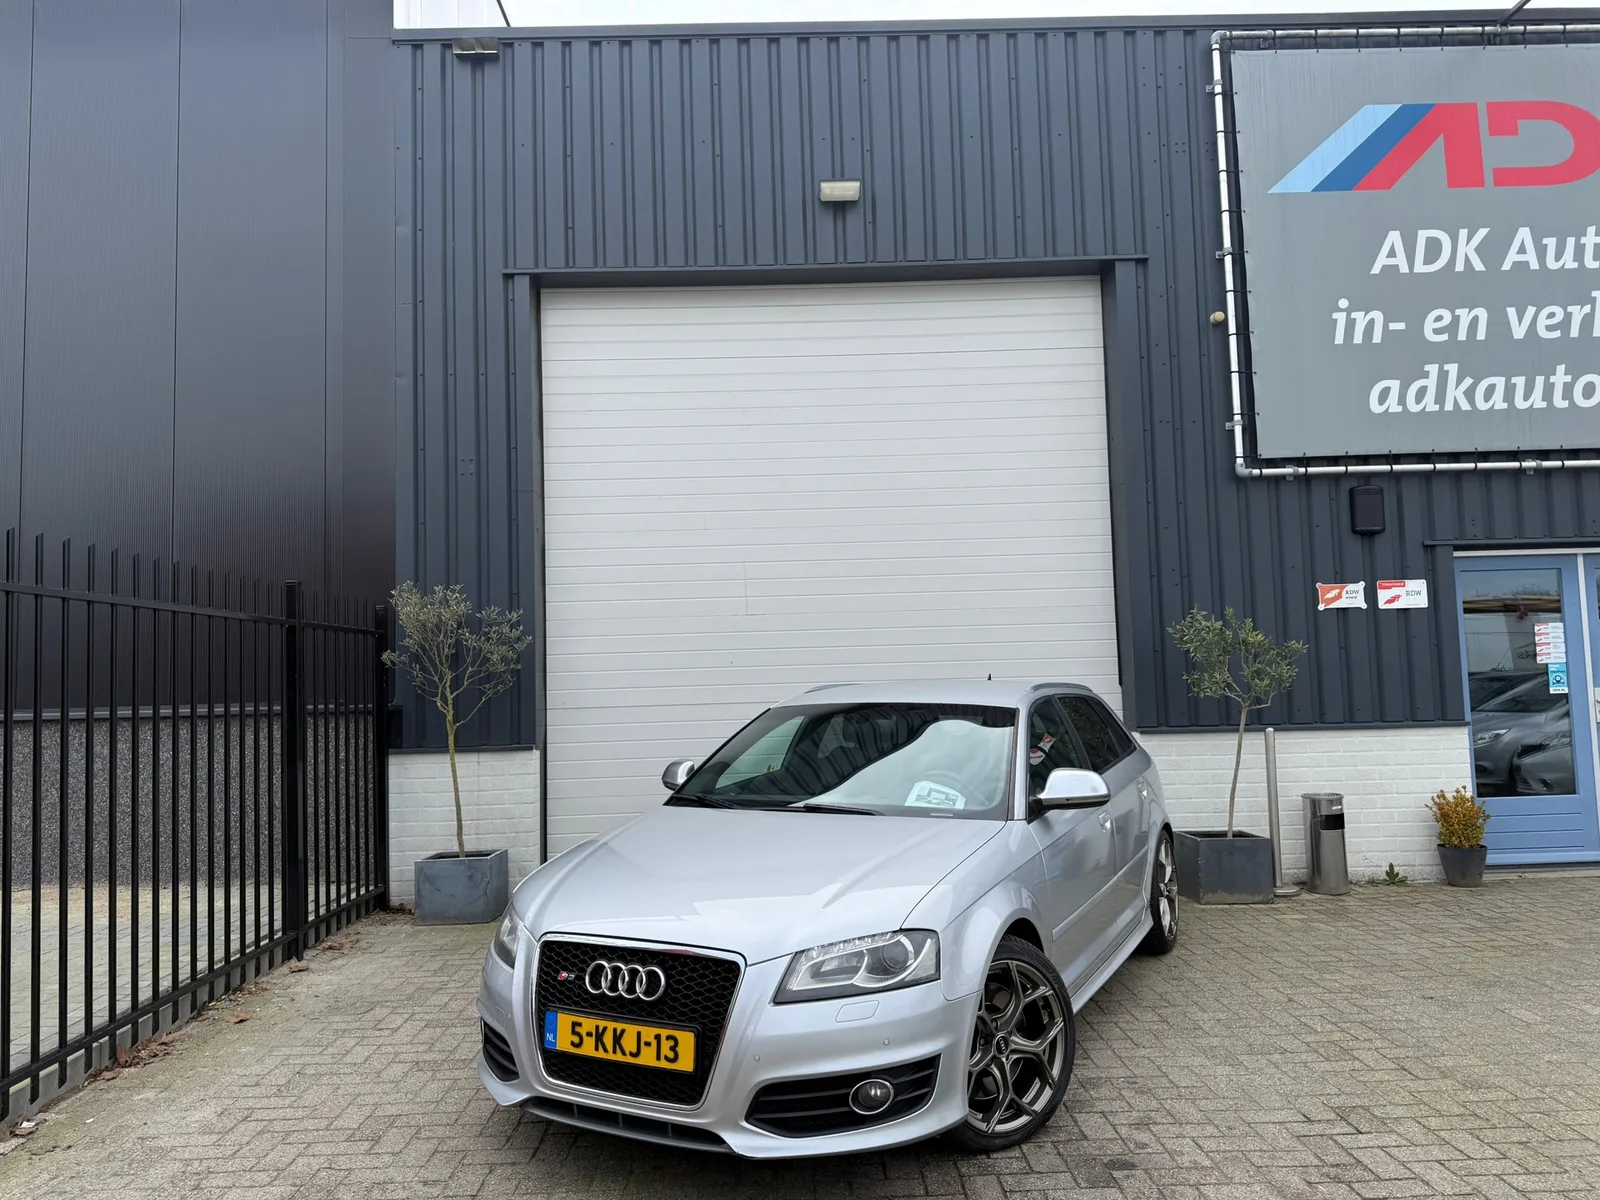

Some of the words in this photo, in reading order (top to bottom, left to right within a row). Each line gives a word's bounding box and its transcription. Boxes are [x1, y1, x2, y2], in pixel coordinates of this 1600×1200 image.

[1370, 227, 1491, 275] ADK
[1500, 225, 1600, 271] Aut
[1332, 298, 1406, 345] in-
[1423, 305, 1489, 342] en
[1369, 363, 1600, 414] adkauto
[1405, 589, 1422, 597] RDW
[546, 1032, 556, 1043] NL
[570, 1020, 679, 1064] 5-KKJ-13
